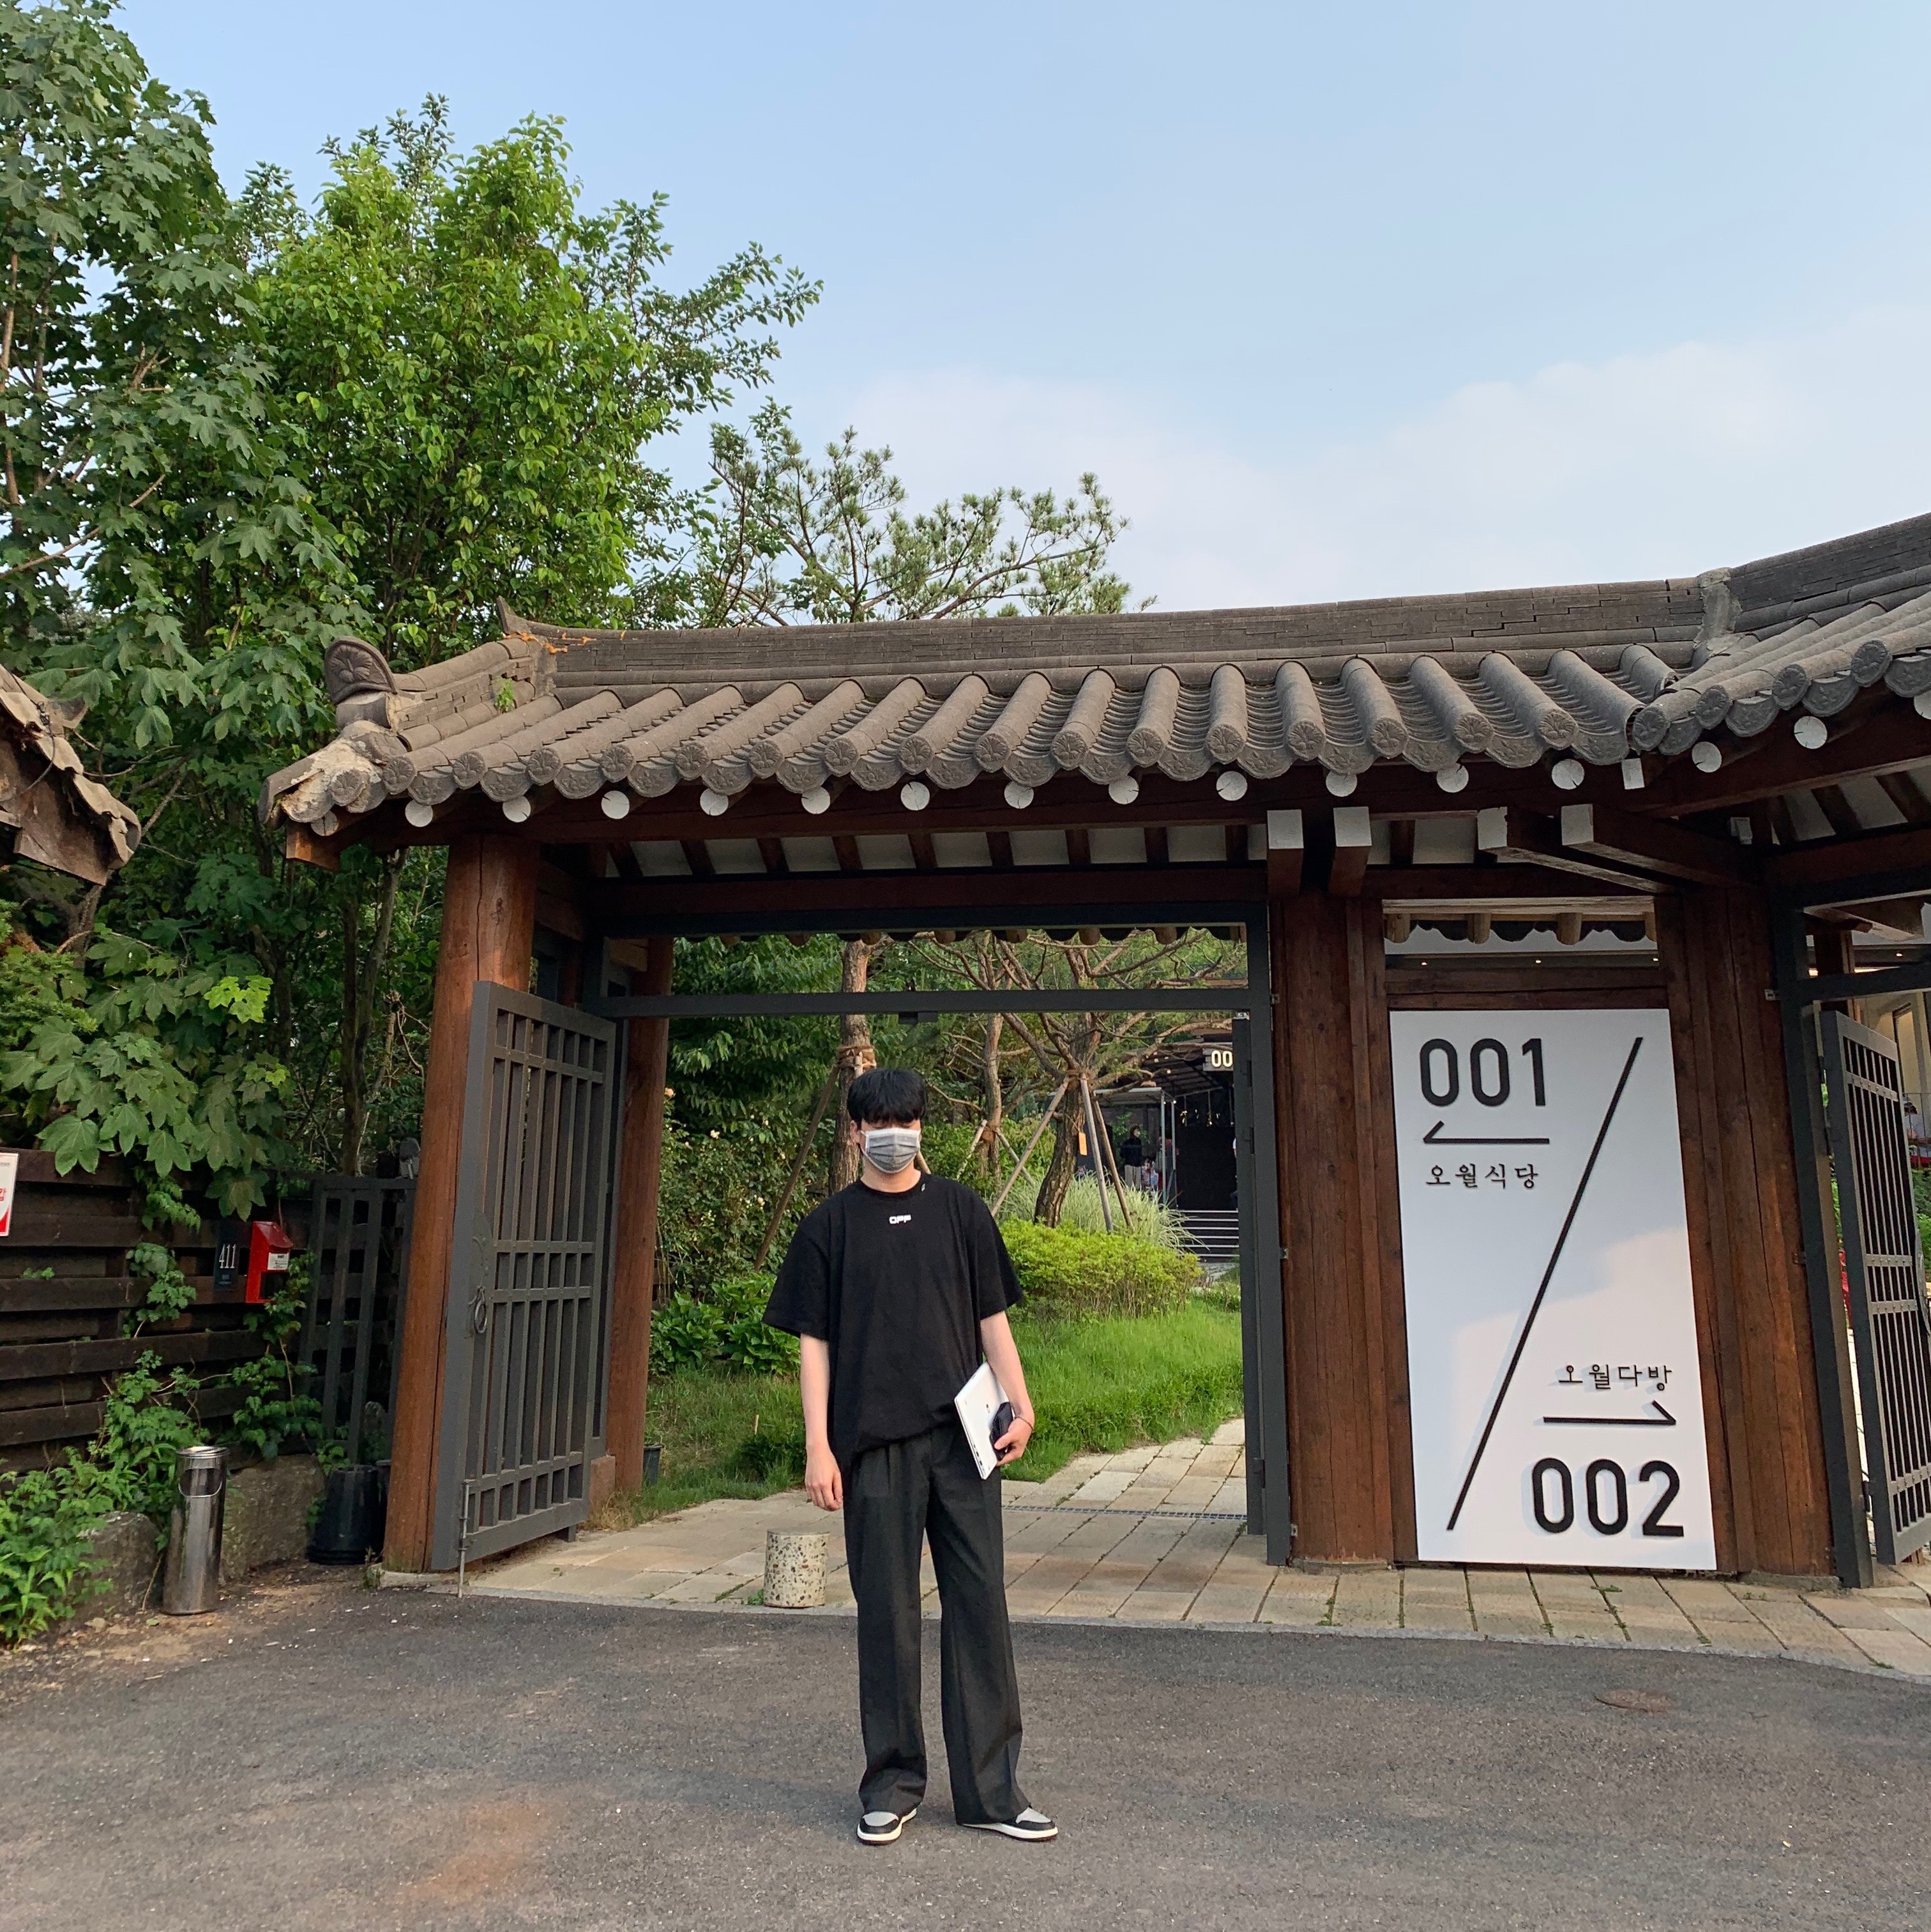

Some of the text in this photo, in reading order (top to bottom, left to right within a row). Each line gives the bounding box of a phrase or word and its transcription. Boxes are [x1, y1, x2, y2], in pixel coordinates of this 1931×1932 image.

[1420, 1038, 1546, 1107] 001
[1426, 1164, 1539, 1189] 오월식당
[218, 1244, 236, 1268] 411
[1558, 1364, 1672, 1391] 오월다방
[1532, 1457, 1685, 1537] 002
